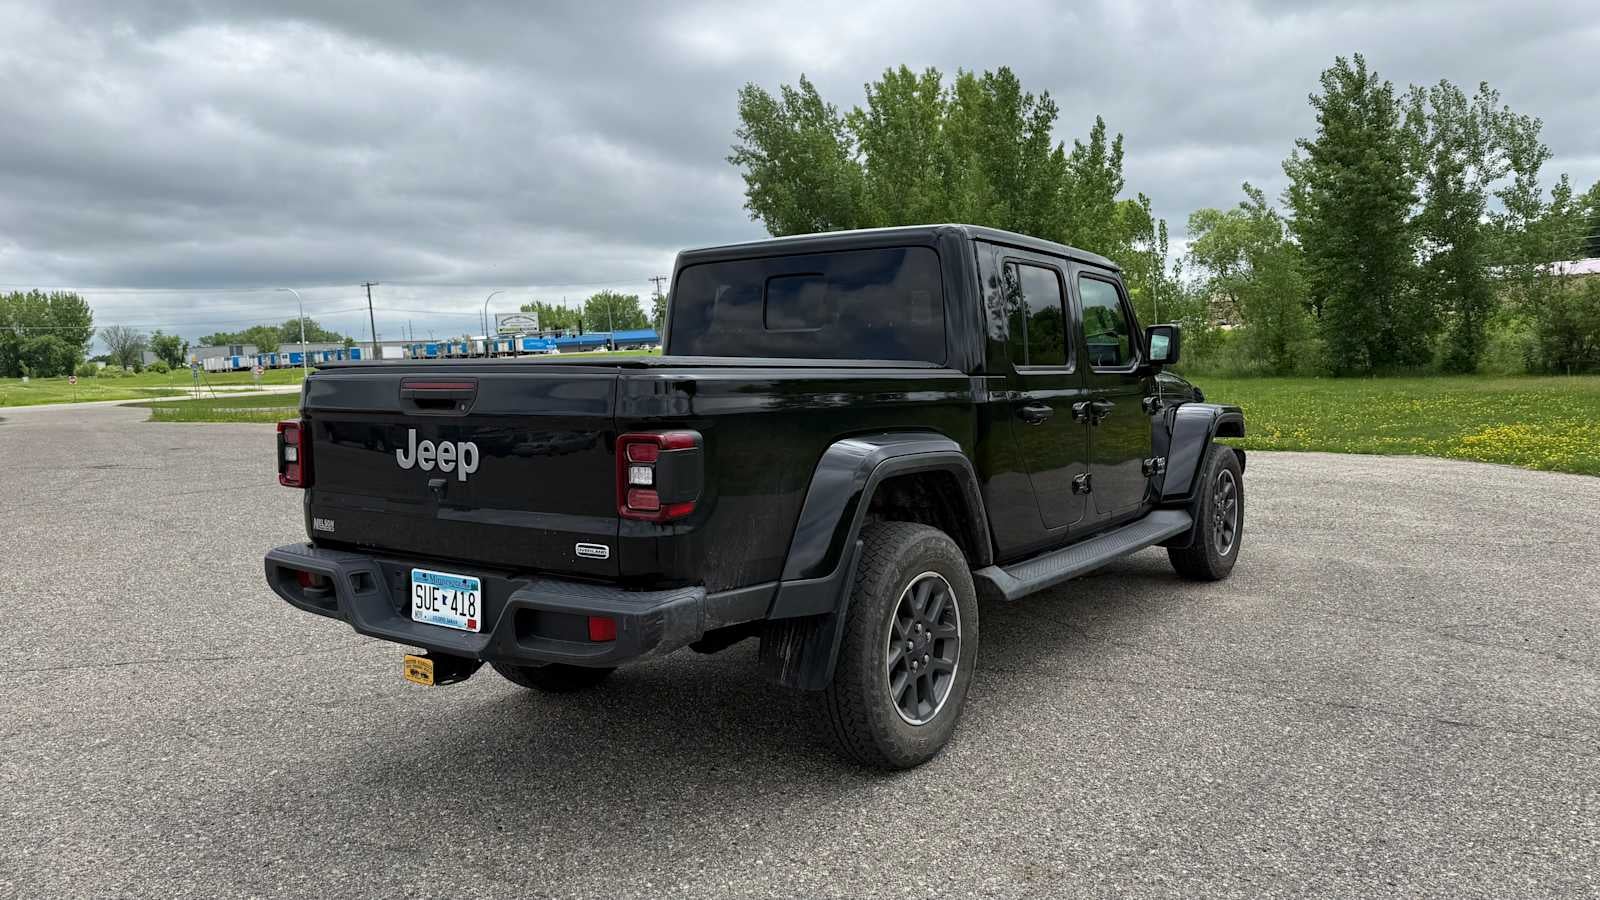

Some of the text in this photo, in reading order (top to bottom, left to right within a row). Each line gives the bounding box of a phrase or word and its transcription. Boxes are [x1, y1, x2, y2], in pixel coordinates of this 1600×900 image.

[396, 428, 479, 482] Jeep
[313, 518, 335, 530] NELSON
[416, 584, 476, 617] SUE 418
